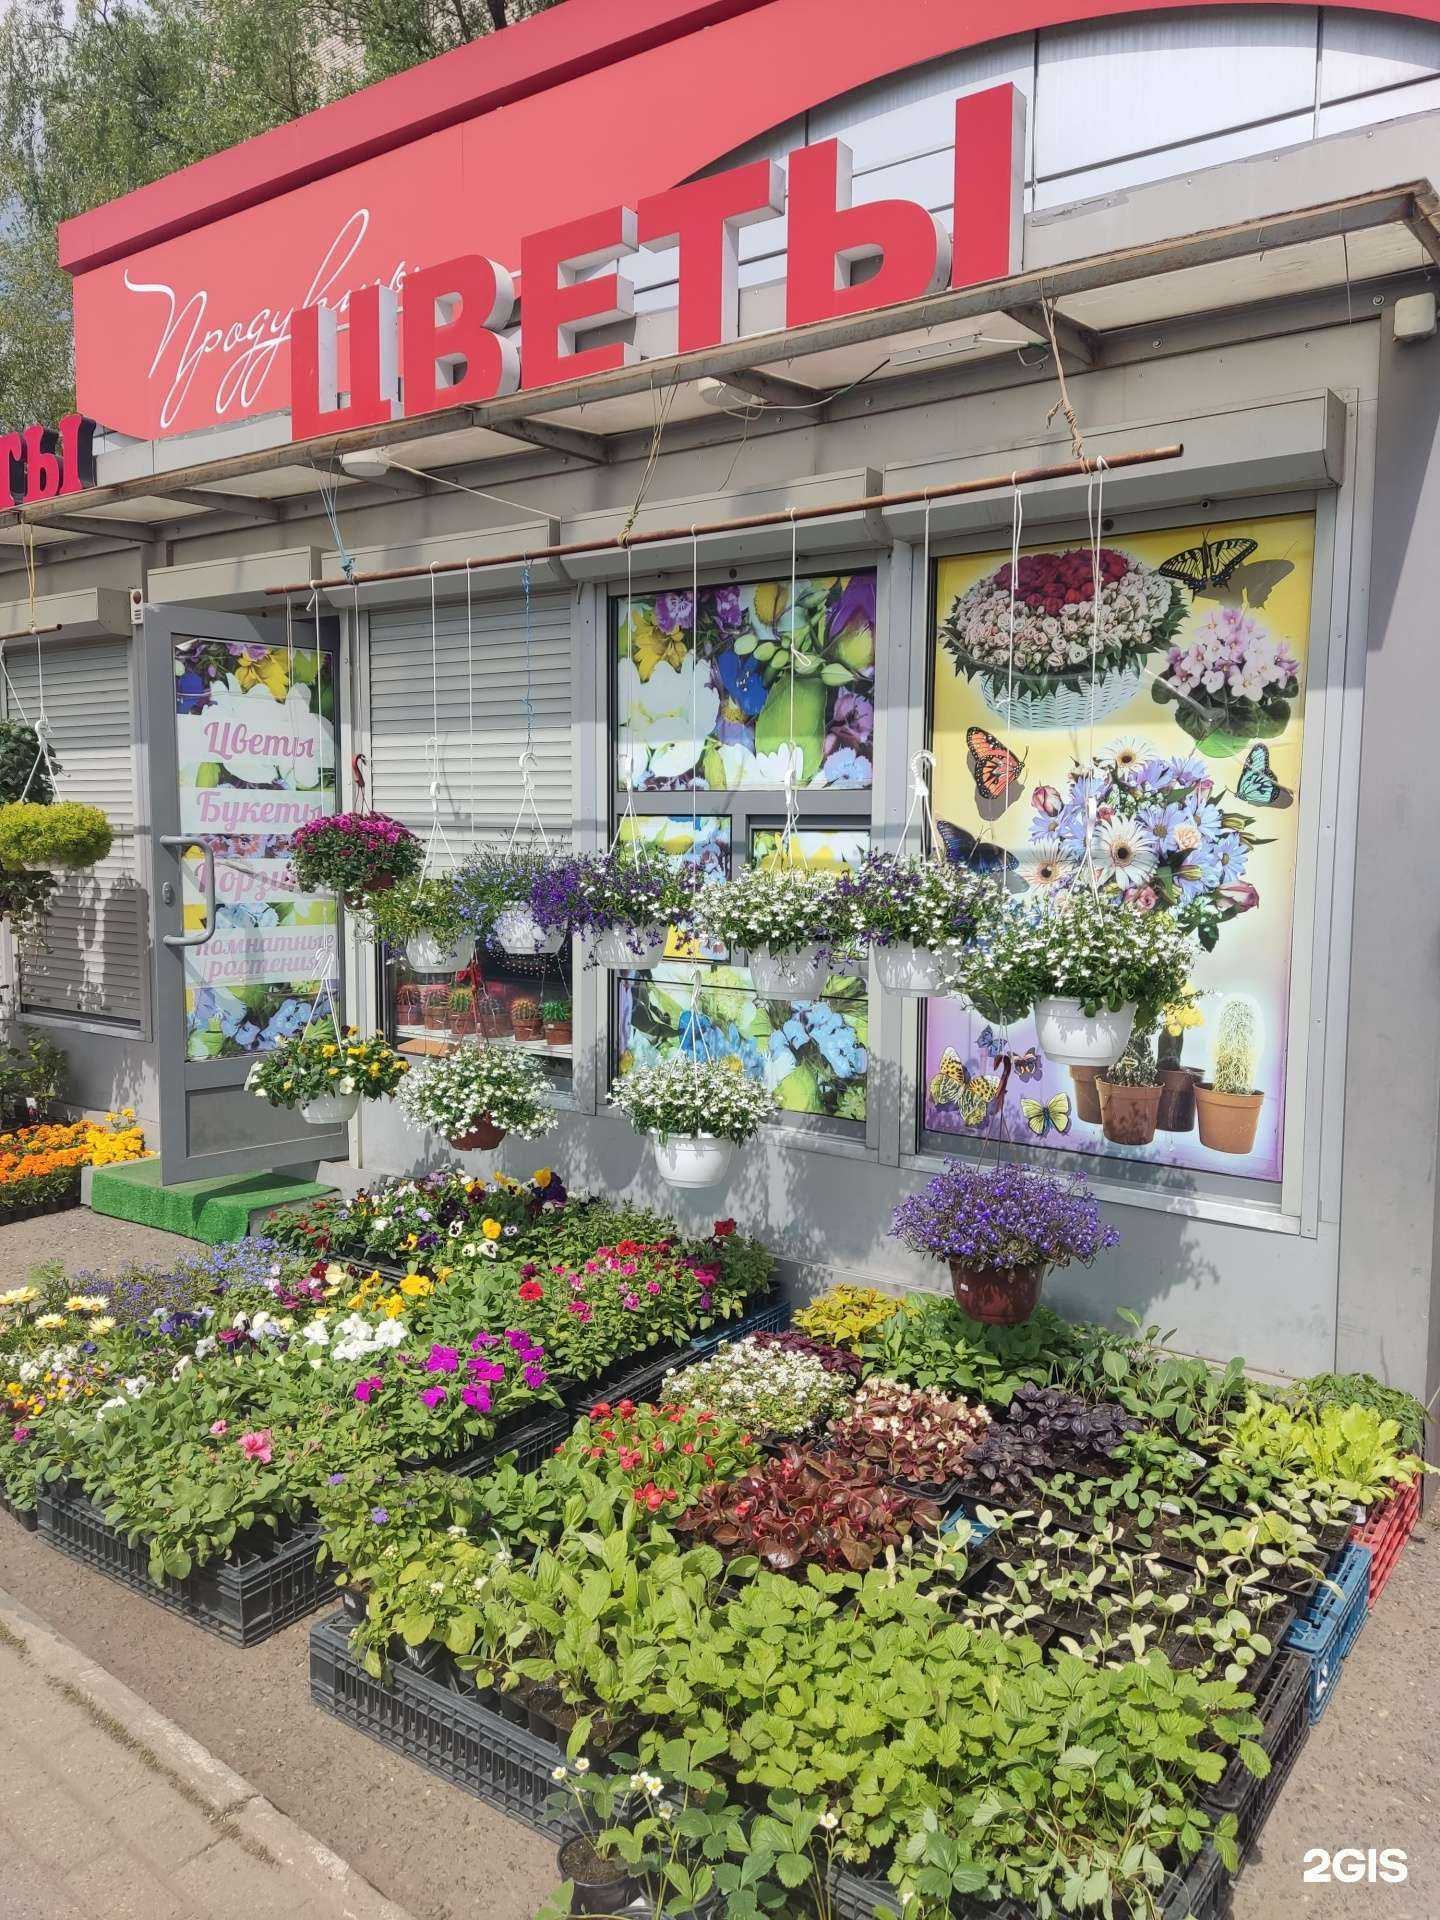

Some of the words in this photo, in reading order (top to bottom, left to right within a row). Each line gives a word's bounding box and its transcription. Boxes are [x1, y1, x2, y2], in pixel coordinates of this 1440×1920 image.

[291, 82, 1022, 441] ЦВЕТЫ
[204, 721, 315, 761] Цветы
[196, 790, 323, 832] Букеты
